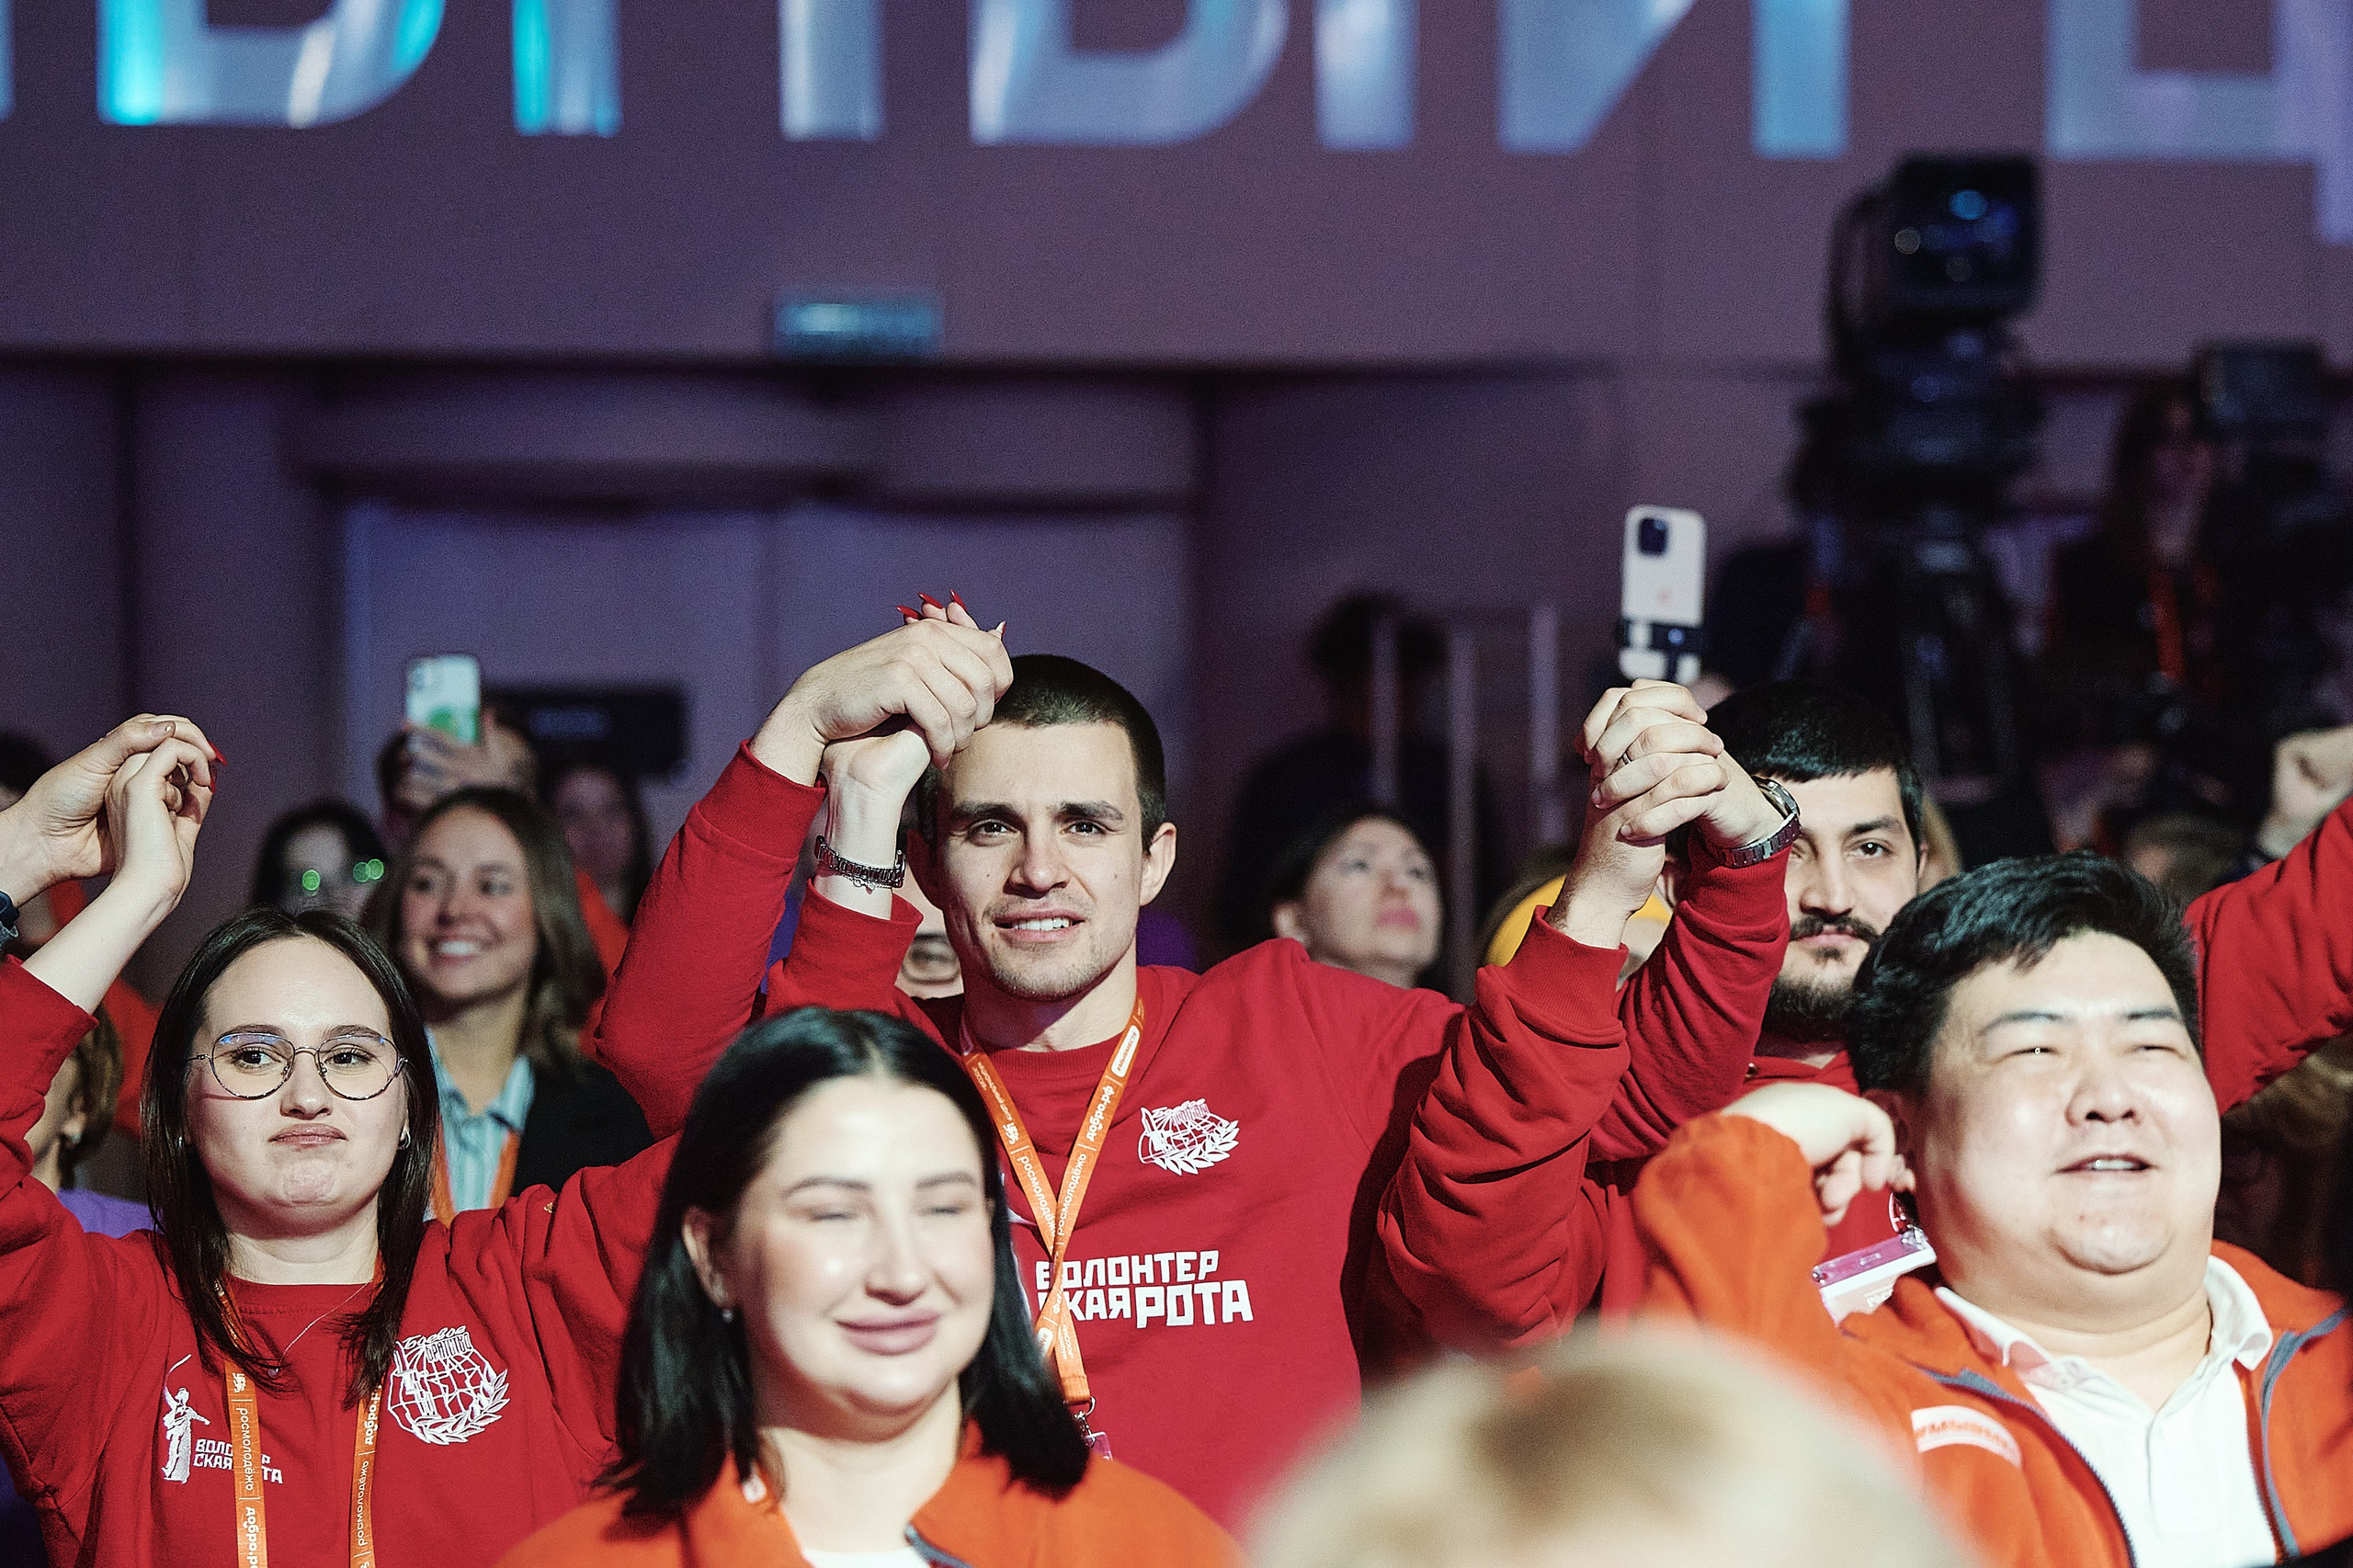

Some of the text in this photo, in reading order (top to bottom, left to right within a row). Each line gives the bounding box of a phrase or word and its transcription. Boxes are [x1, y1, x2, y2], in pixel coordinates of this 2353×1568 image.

[1086, 1085, 1115, 1142] добро.рф
[1057, 1153, 1087, 1236] росмолодёжь
[1135, 1279, 1254, 1329] РОТА
[364, 1385, 382, 1446] добро.р
[193, 1453, 233, 1471] СКАЯ
[235, 1407, 254, 1491] росмолодёжь
[357, 1460, 369, 1546] росмолодёжь
